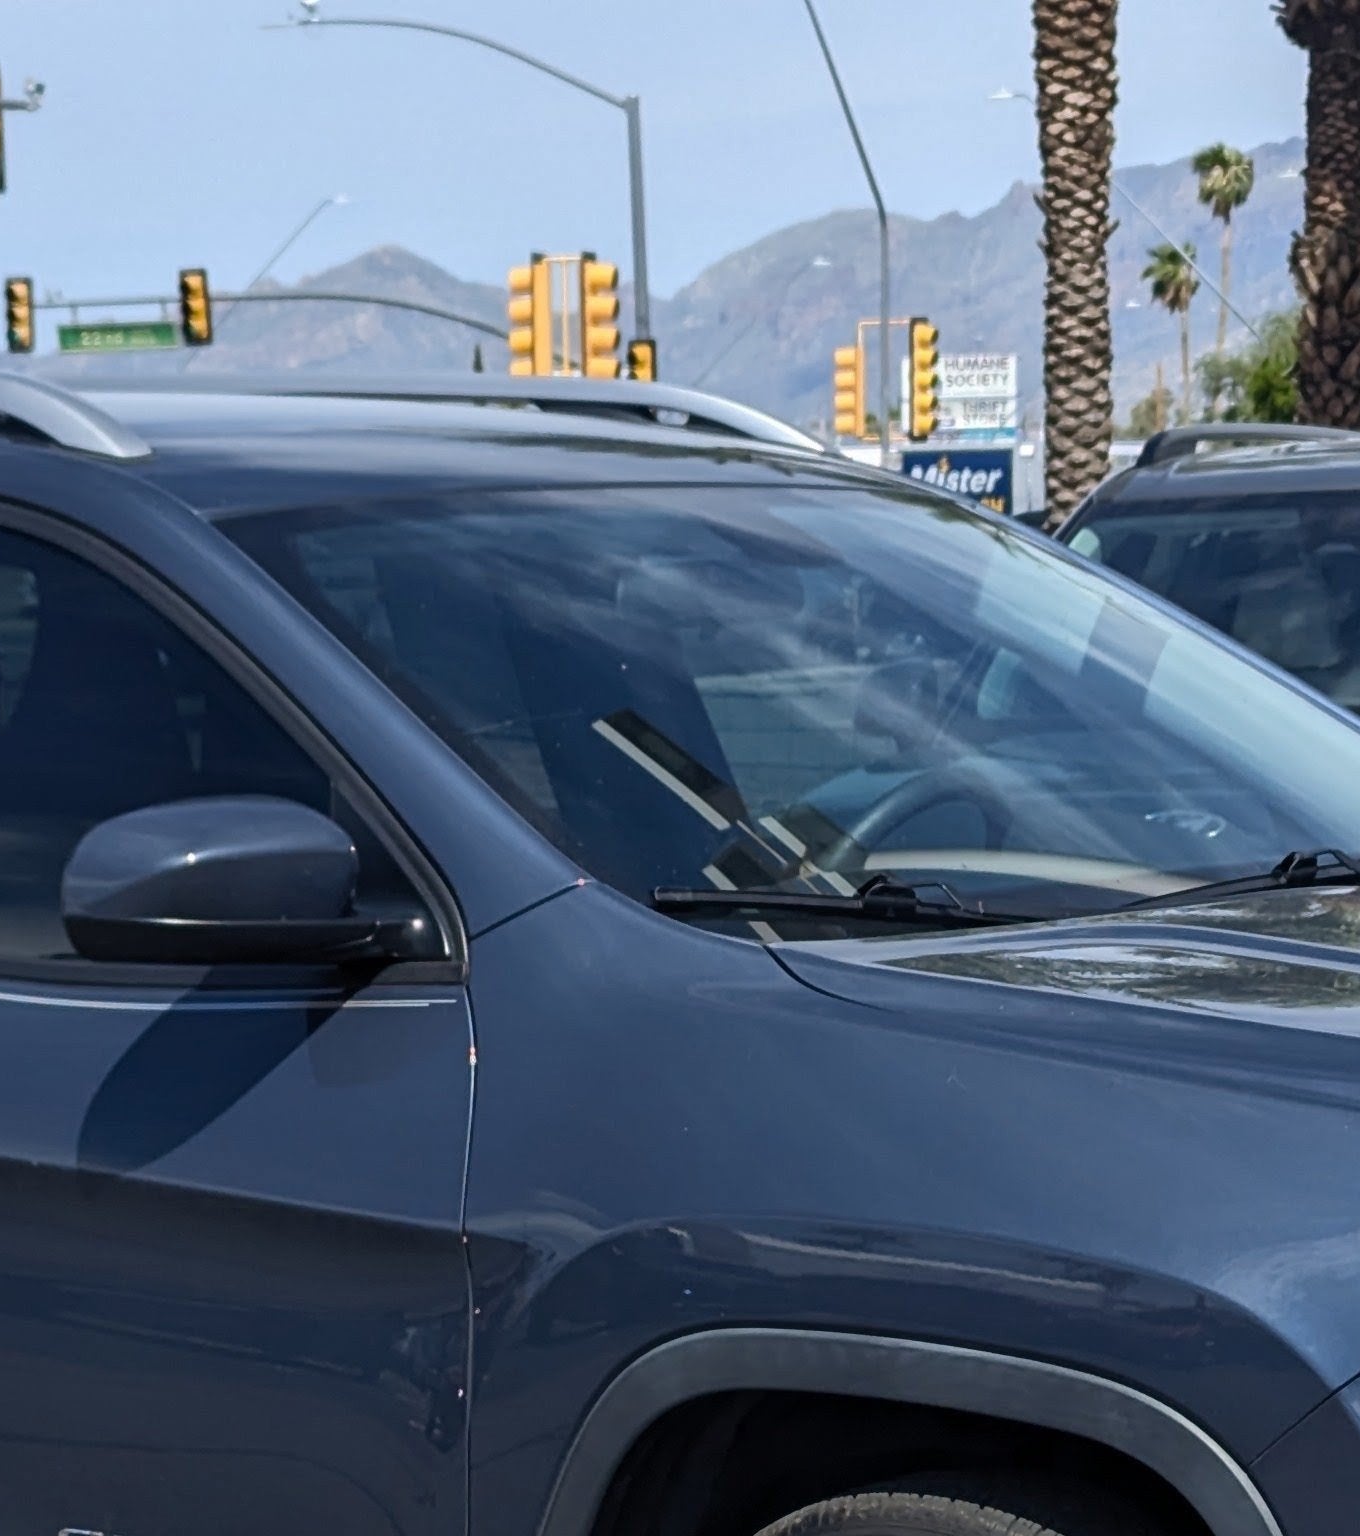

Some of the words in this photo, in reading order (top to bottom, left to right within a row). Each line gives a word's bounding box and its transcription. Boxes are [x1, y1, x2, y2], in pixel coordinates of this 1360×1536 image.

[944, 357, 1009, 371] HUMANE
[945, 373, 1009, 387] SOCIETY
[962, 400, 1007, 413] THRIFT
